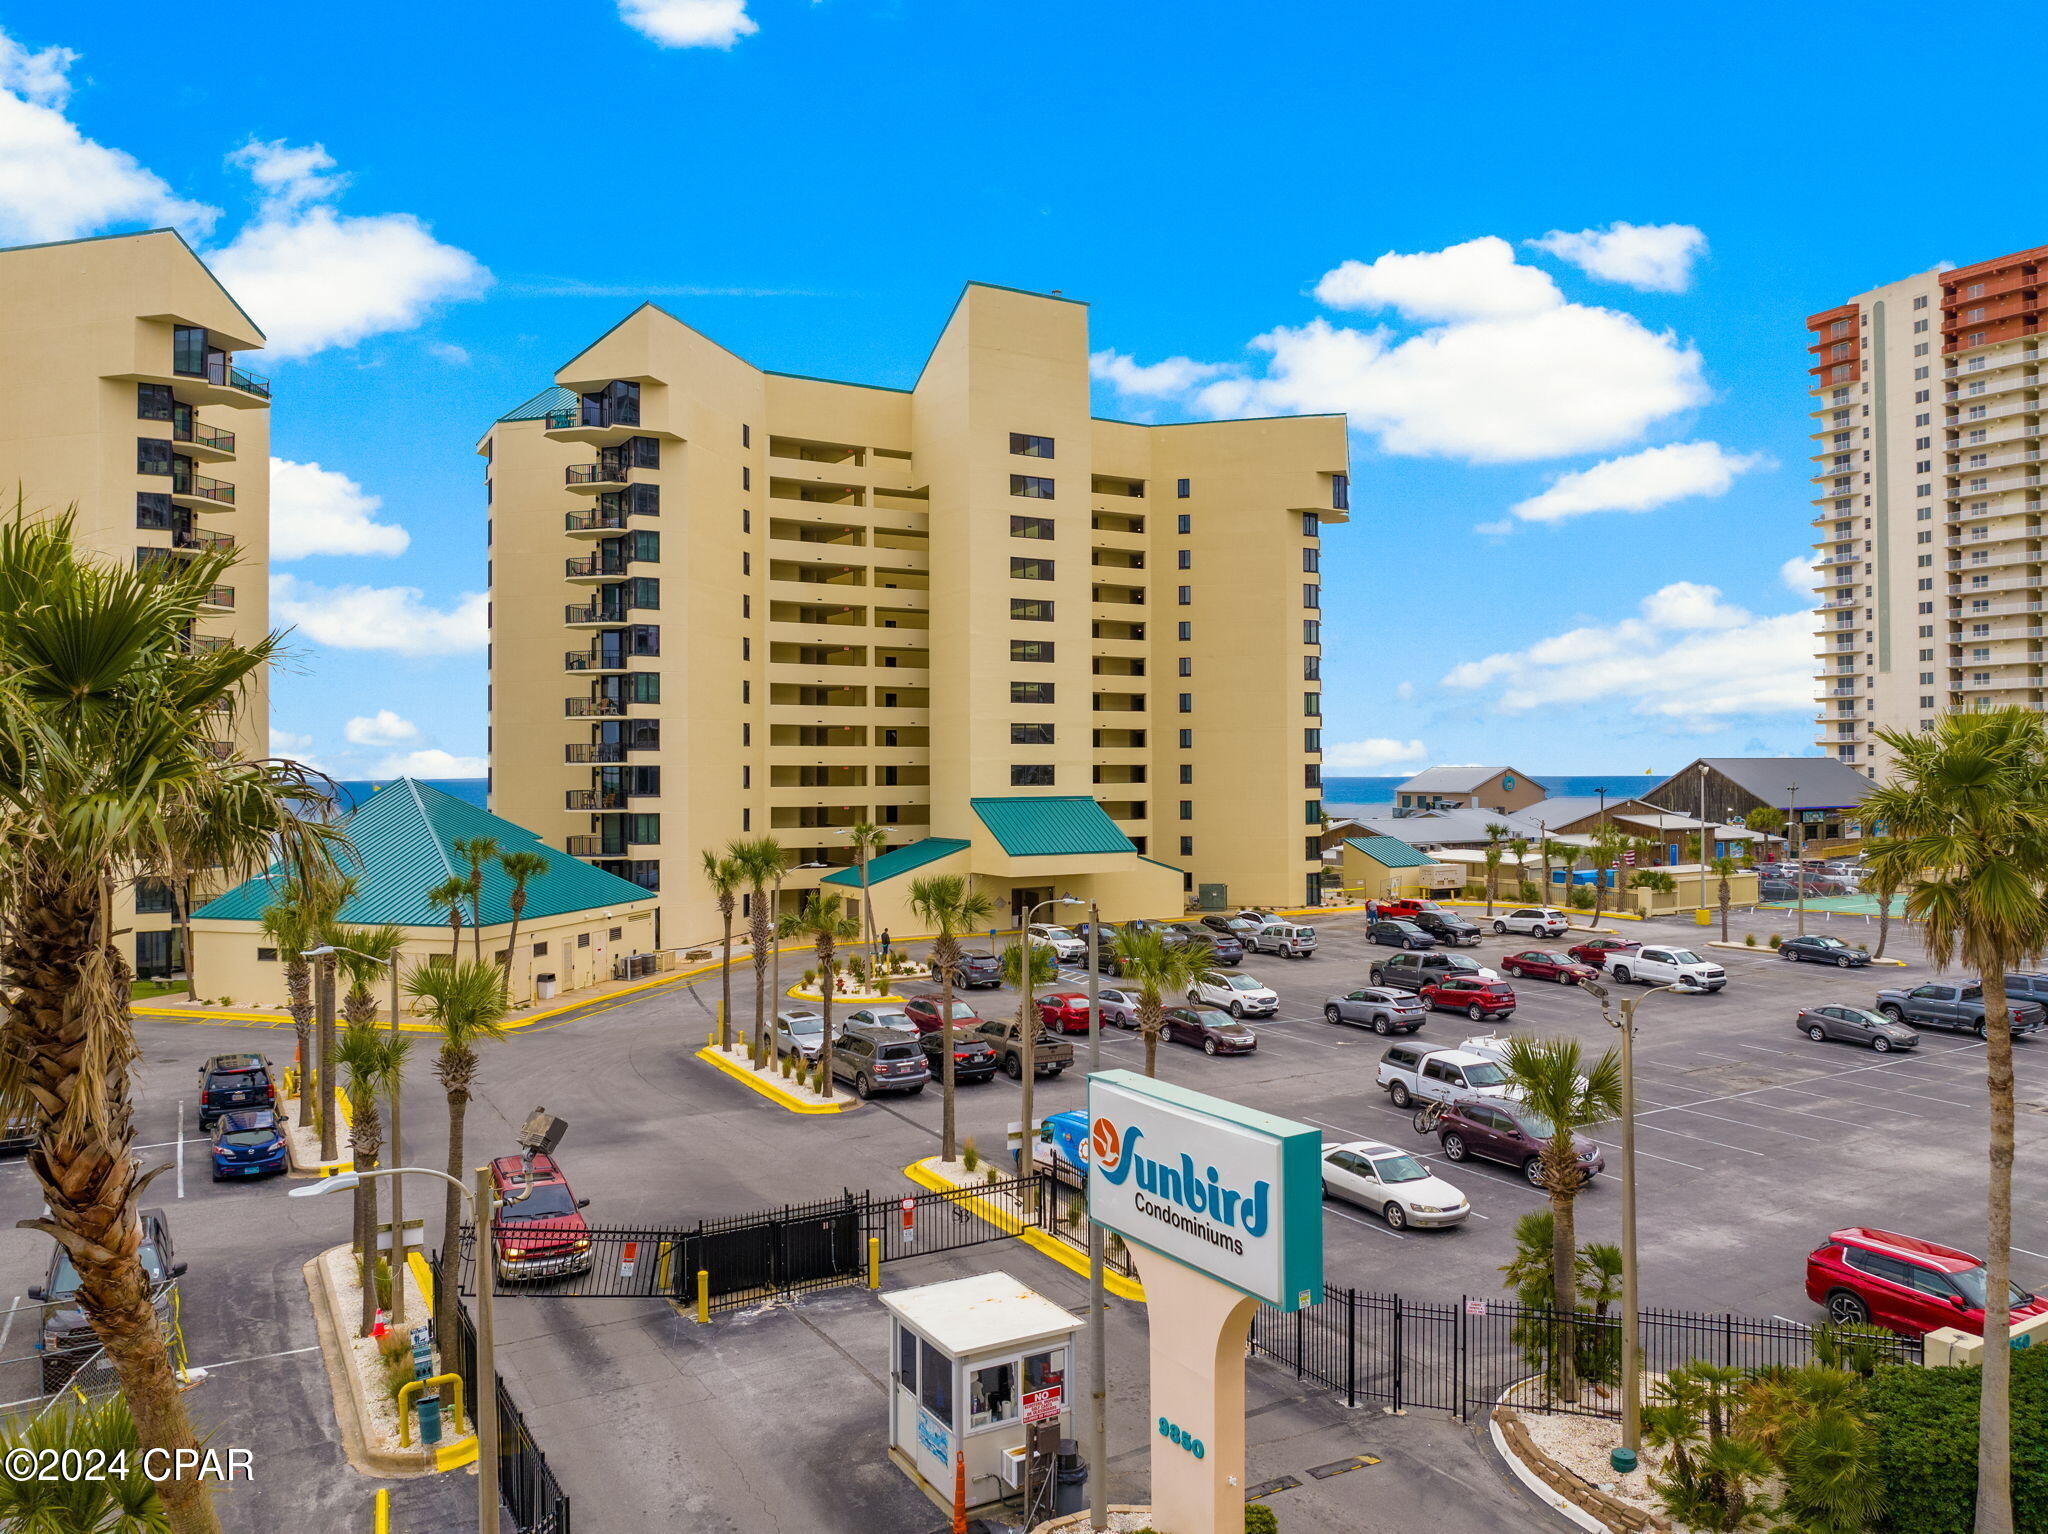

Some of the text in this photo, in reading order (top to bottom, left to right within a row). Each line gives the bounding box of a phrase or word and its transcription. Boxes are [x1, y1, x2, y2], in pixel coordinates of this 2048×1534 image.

[1098, 1126, 1270, 1238] Sunbird
[1135, 1192, 1244, 1256] Condominiums
[1034, 1391, 1049, 1401] NO
[1158, 1416, 1205, 1459] 9850
